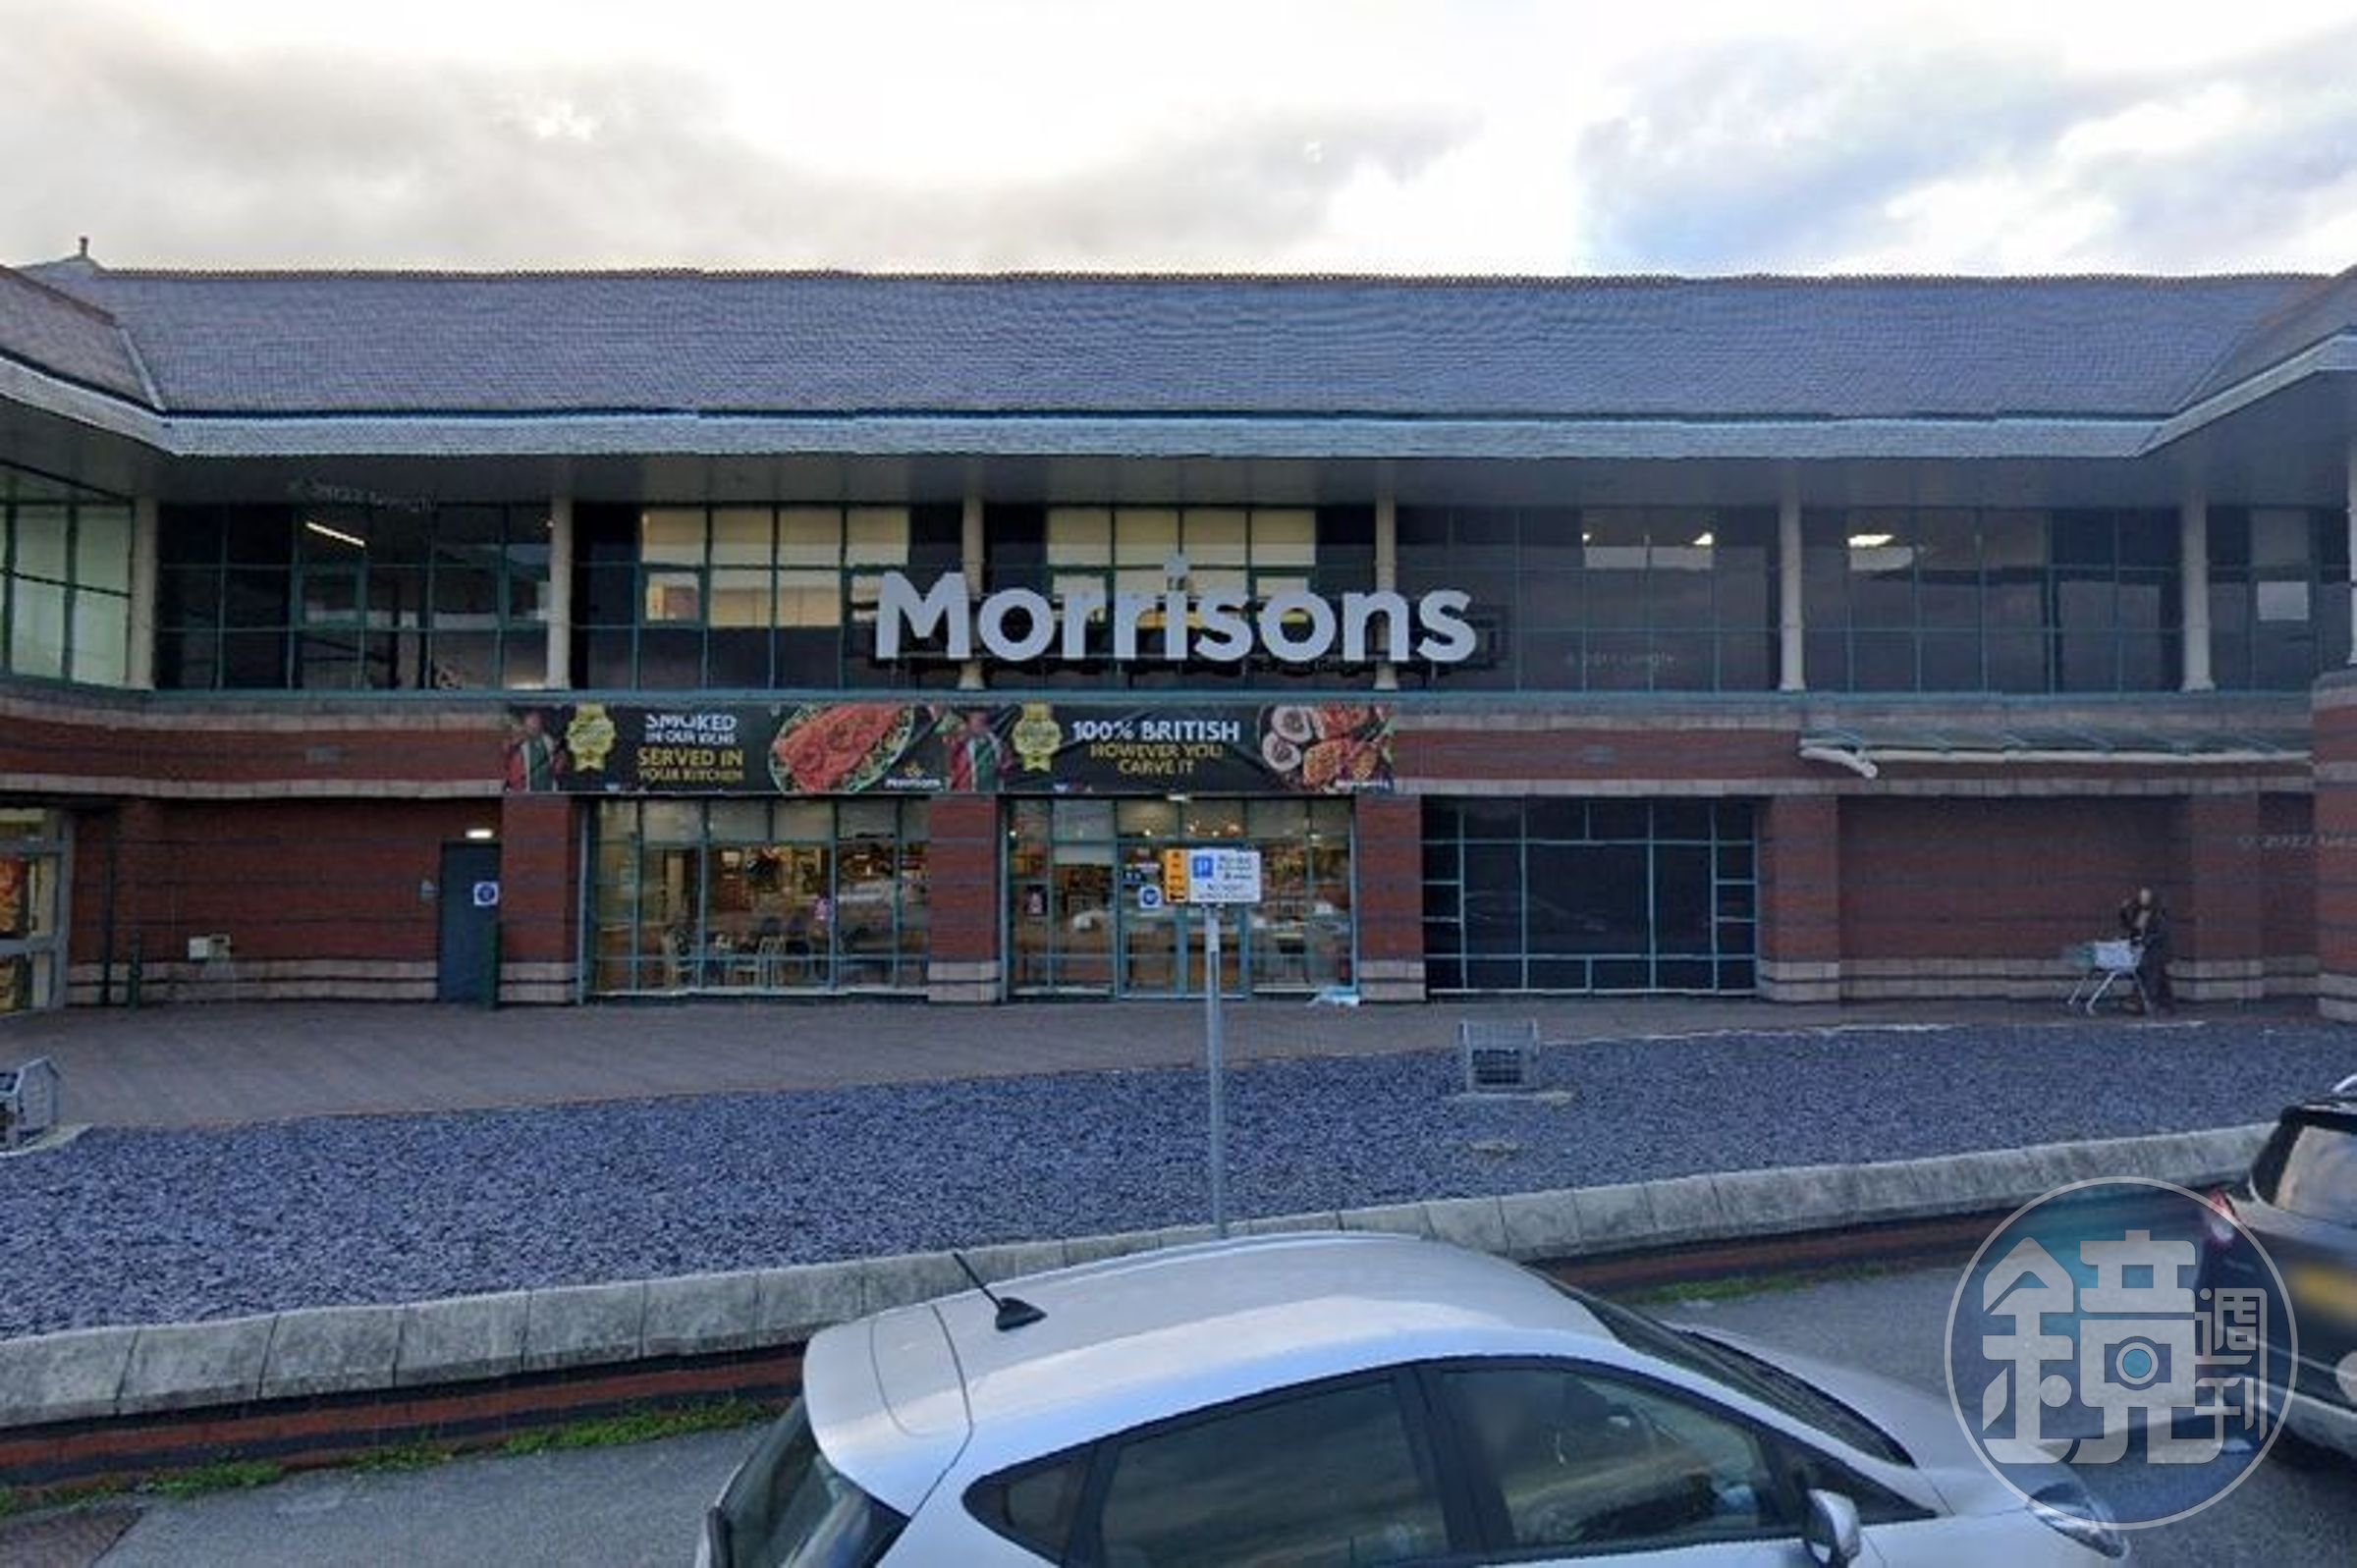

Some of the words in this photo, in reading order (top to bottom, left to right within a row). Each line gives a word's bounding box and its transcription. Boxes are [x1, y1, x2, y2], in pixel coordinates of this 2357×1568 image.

[875, 553, 1476, 662] Morrisons
[644, 713, 738, 731] SMOKED
[1071, 720, 1135, 741] 100%
[1140, 721, 1240, 742] BRITISH
[636, 746, 716, 766] SERVED
[720, 748, 744, 767] IN
[1090, 743, 1180, 759] HOWEVER
[1184, 743, 1224, 759] YOU
[1118, 759, 1176, 775] CARVE
[1178, 760, 1195, 775] IT
